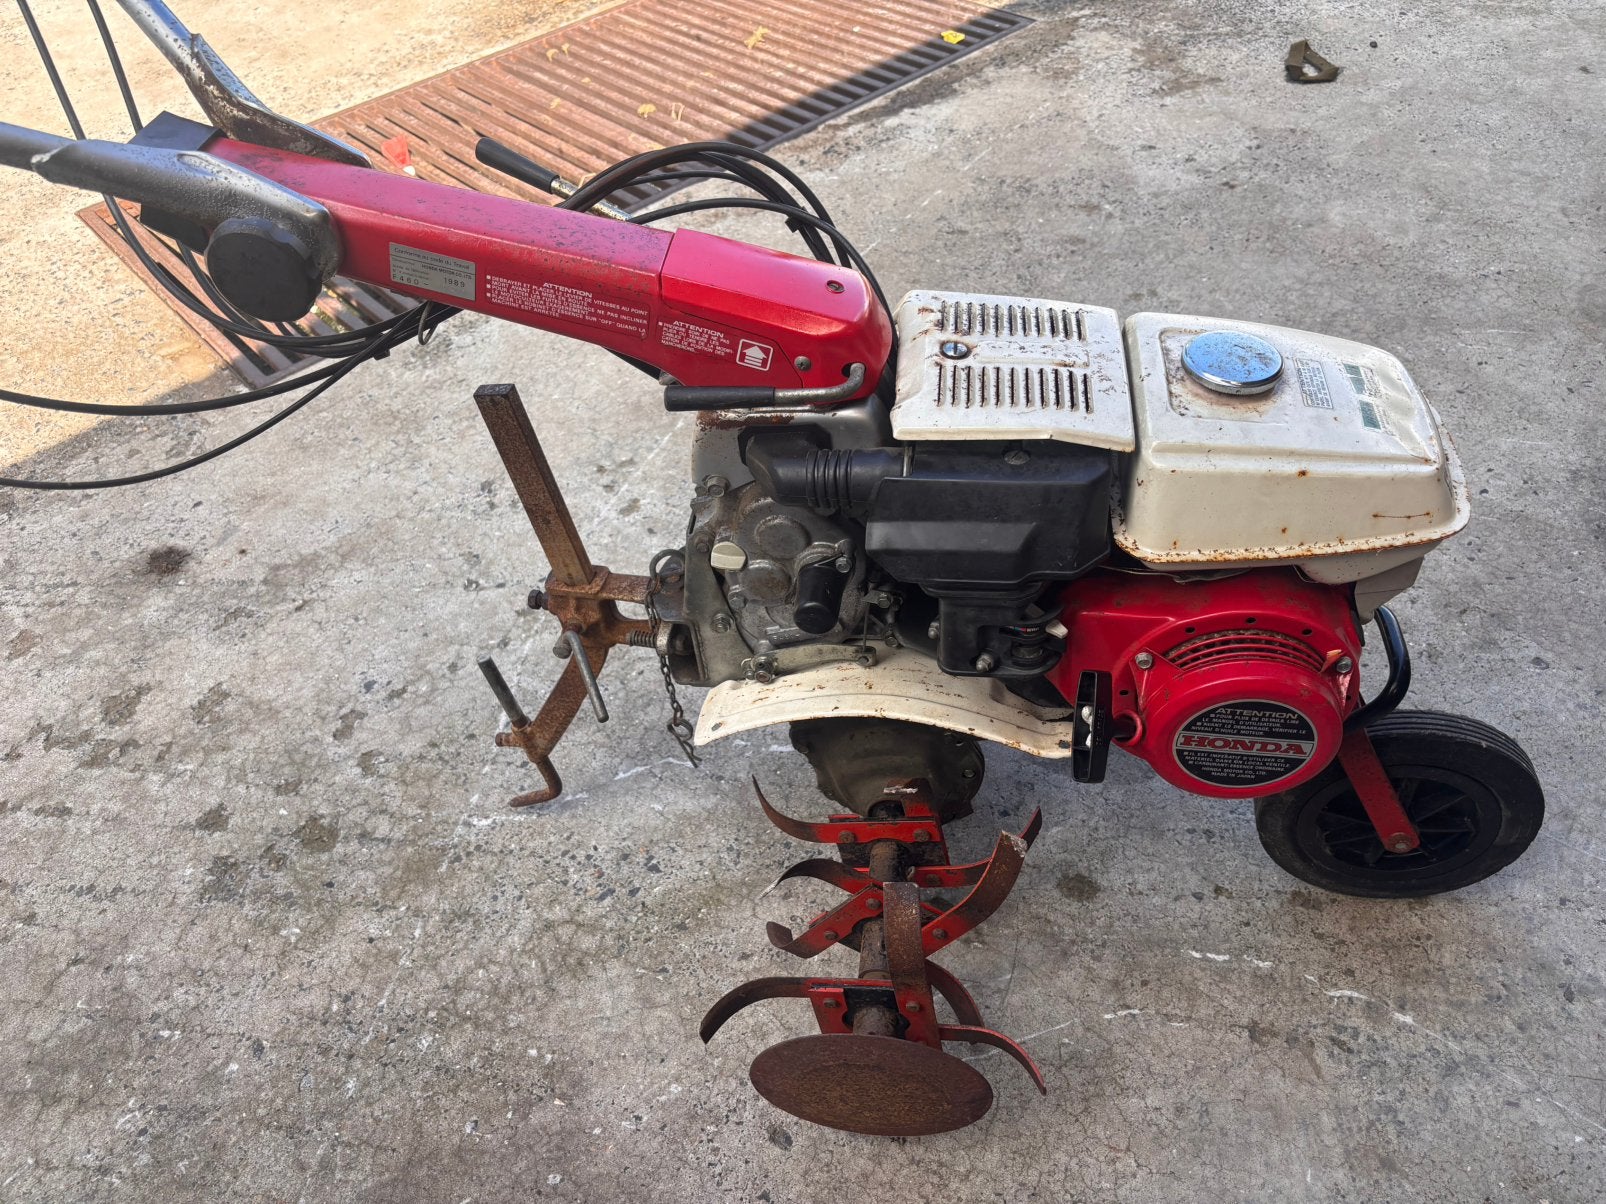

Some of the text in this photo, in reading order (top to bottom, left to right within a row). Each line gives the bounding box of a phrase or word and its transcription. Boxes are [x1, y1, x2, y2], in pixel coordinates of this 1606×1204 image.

[394, 248, 421, 258] Conforme
[445, 278, 465, 287] 1989
[492, 276, 521, 285] DEBRAYER
[533, 285, 554, 293] PLACER
[564, 292, 582, 300] LEVIER
[594, 300, 620, 309] VITESSES
[512, 285, 530, 293] AVANT
[543, 282, 593, 298] ATTENTION
[492, 298, 519, 308] MACHINE
[501, 291, 543, 305] MOTOCULTEUR
[492, 293, 513, 302] PLACER
[525, 300, 549, 310] ROBINET
[616, 322, 637, 331] QUAND
[620, 314, 647, 324] INCLINER
[673, 321, 724, 338] ATTENTION
[691, 343, 712, 352] POSITION
[1215, 707, 1298, 719] ATTENTION
[1181, 735, 1307, 755] HONDA
